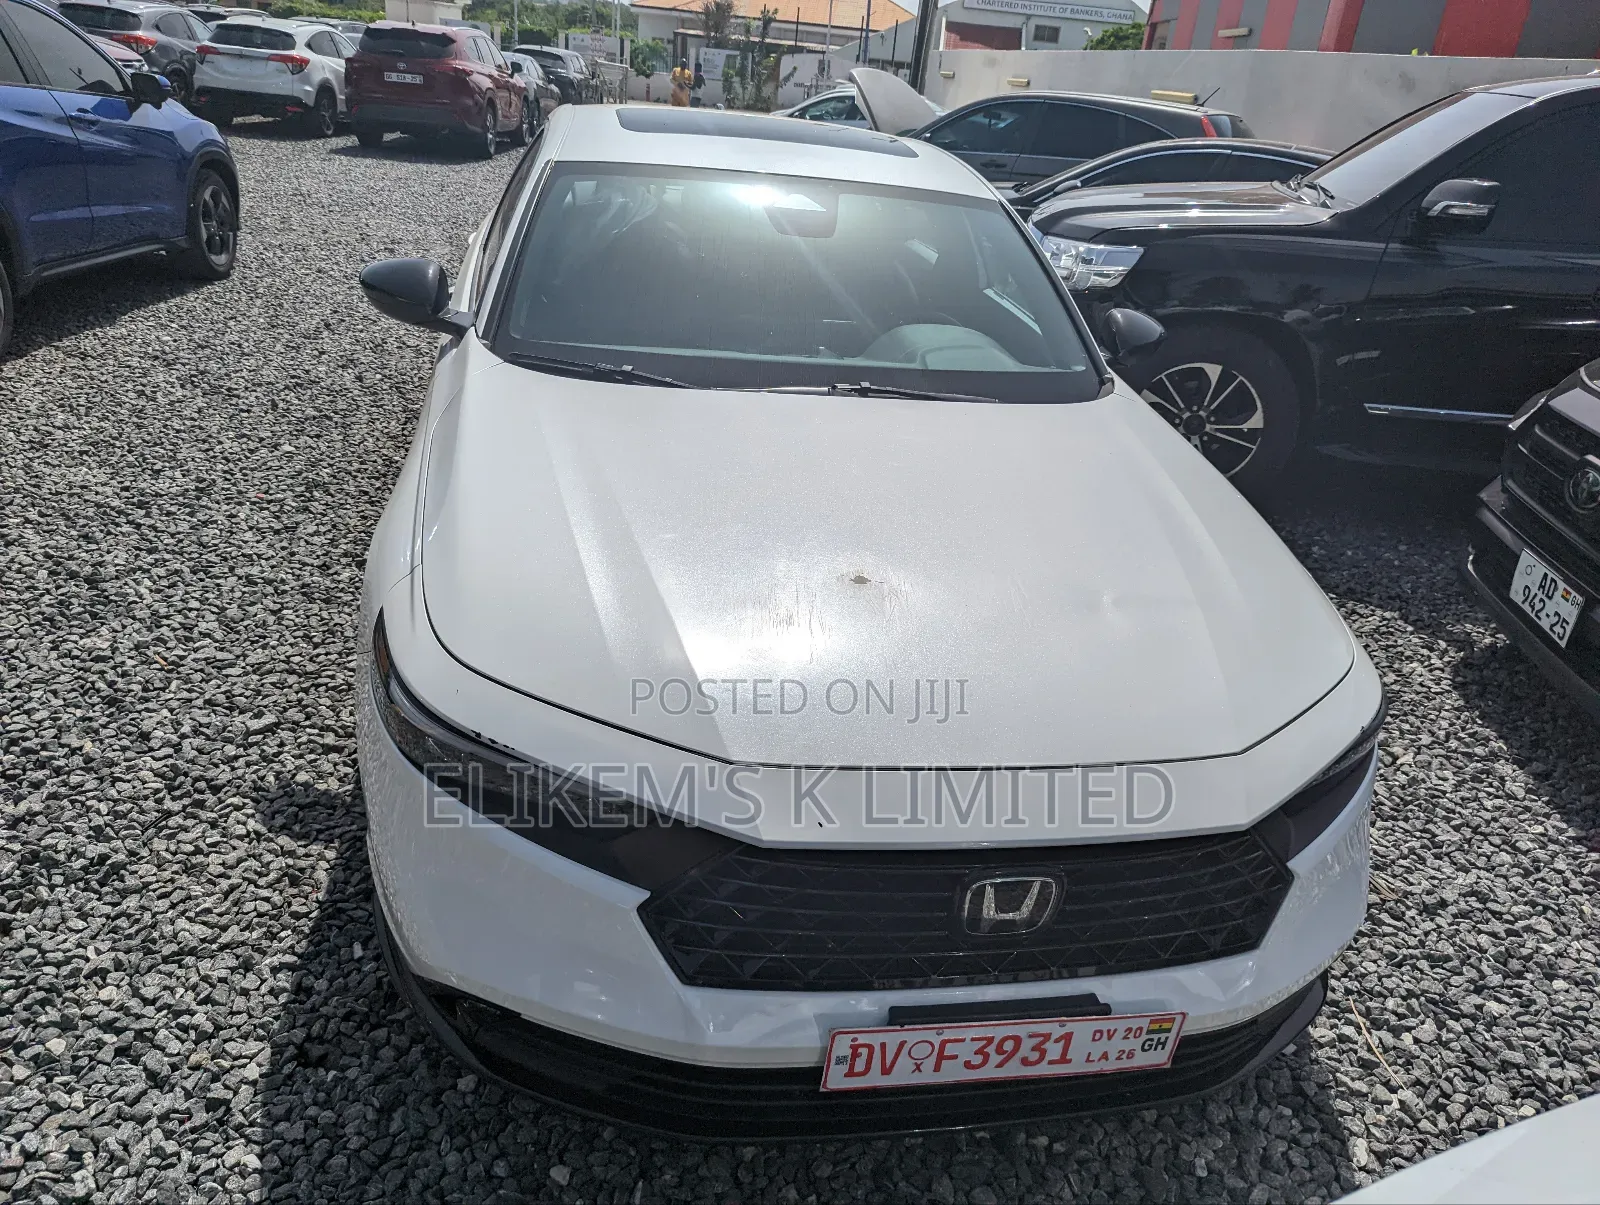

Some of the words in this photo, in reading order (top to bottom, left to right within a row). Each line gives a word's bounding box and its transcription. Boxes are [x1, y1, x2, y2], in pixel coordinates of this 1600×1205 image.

[977, 0, 1019, 9] CHARTERED
[1020, 4, 1057, 14] INSTITUTE
[1069, 7, 1105, 19] BANKERS,
[1106, 12, 1133, 20] GHANA
[1537, 571, 1558, 601] AD
[1570, 595, 1581, 610] GH
[1520, 584, 1570, 641] 942-25
[1090, 1027, 1119, 1043] DV
[1121, 1025, 1144, 1041] 20
[1140, 1035, 1170, 1053] GH
[932, 1030, 1075, 1073] F3931
[1084, 1050, 1110, 1064] LA
[1115, 1048, 1137, 1061] 26
